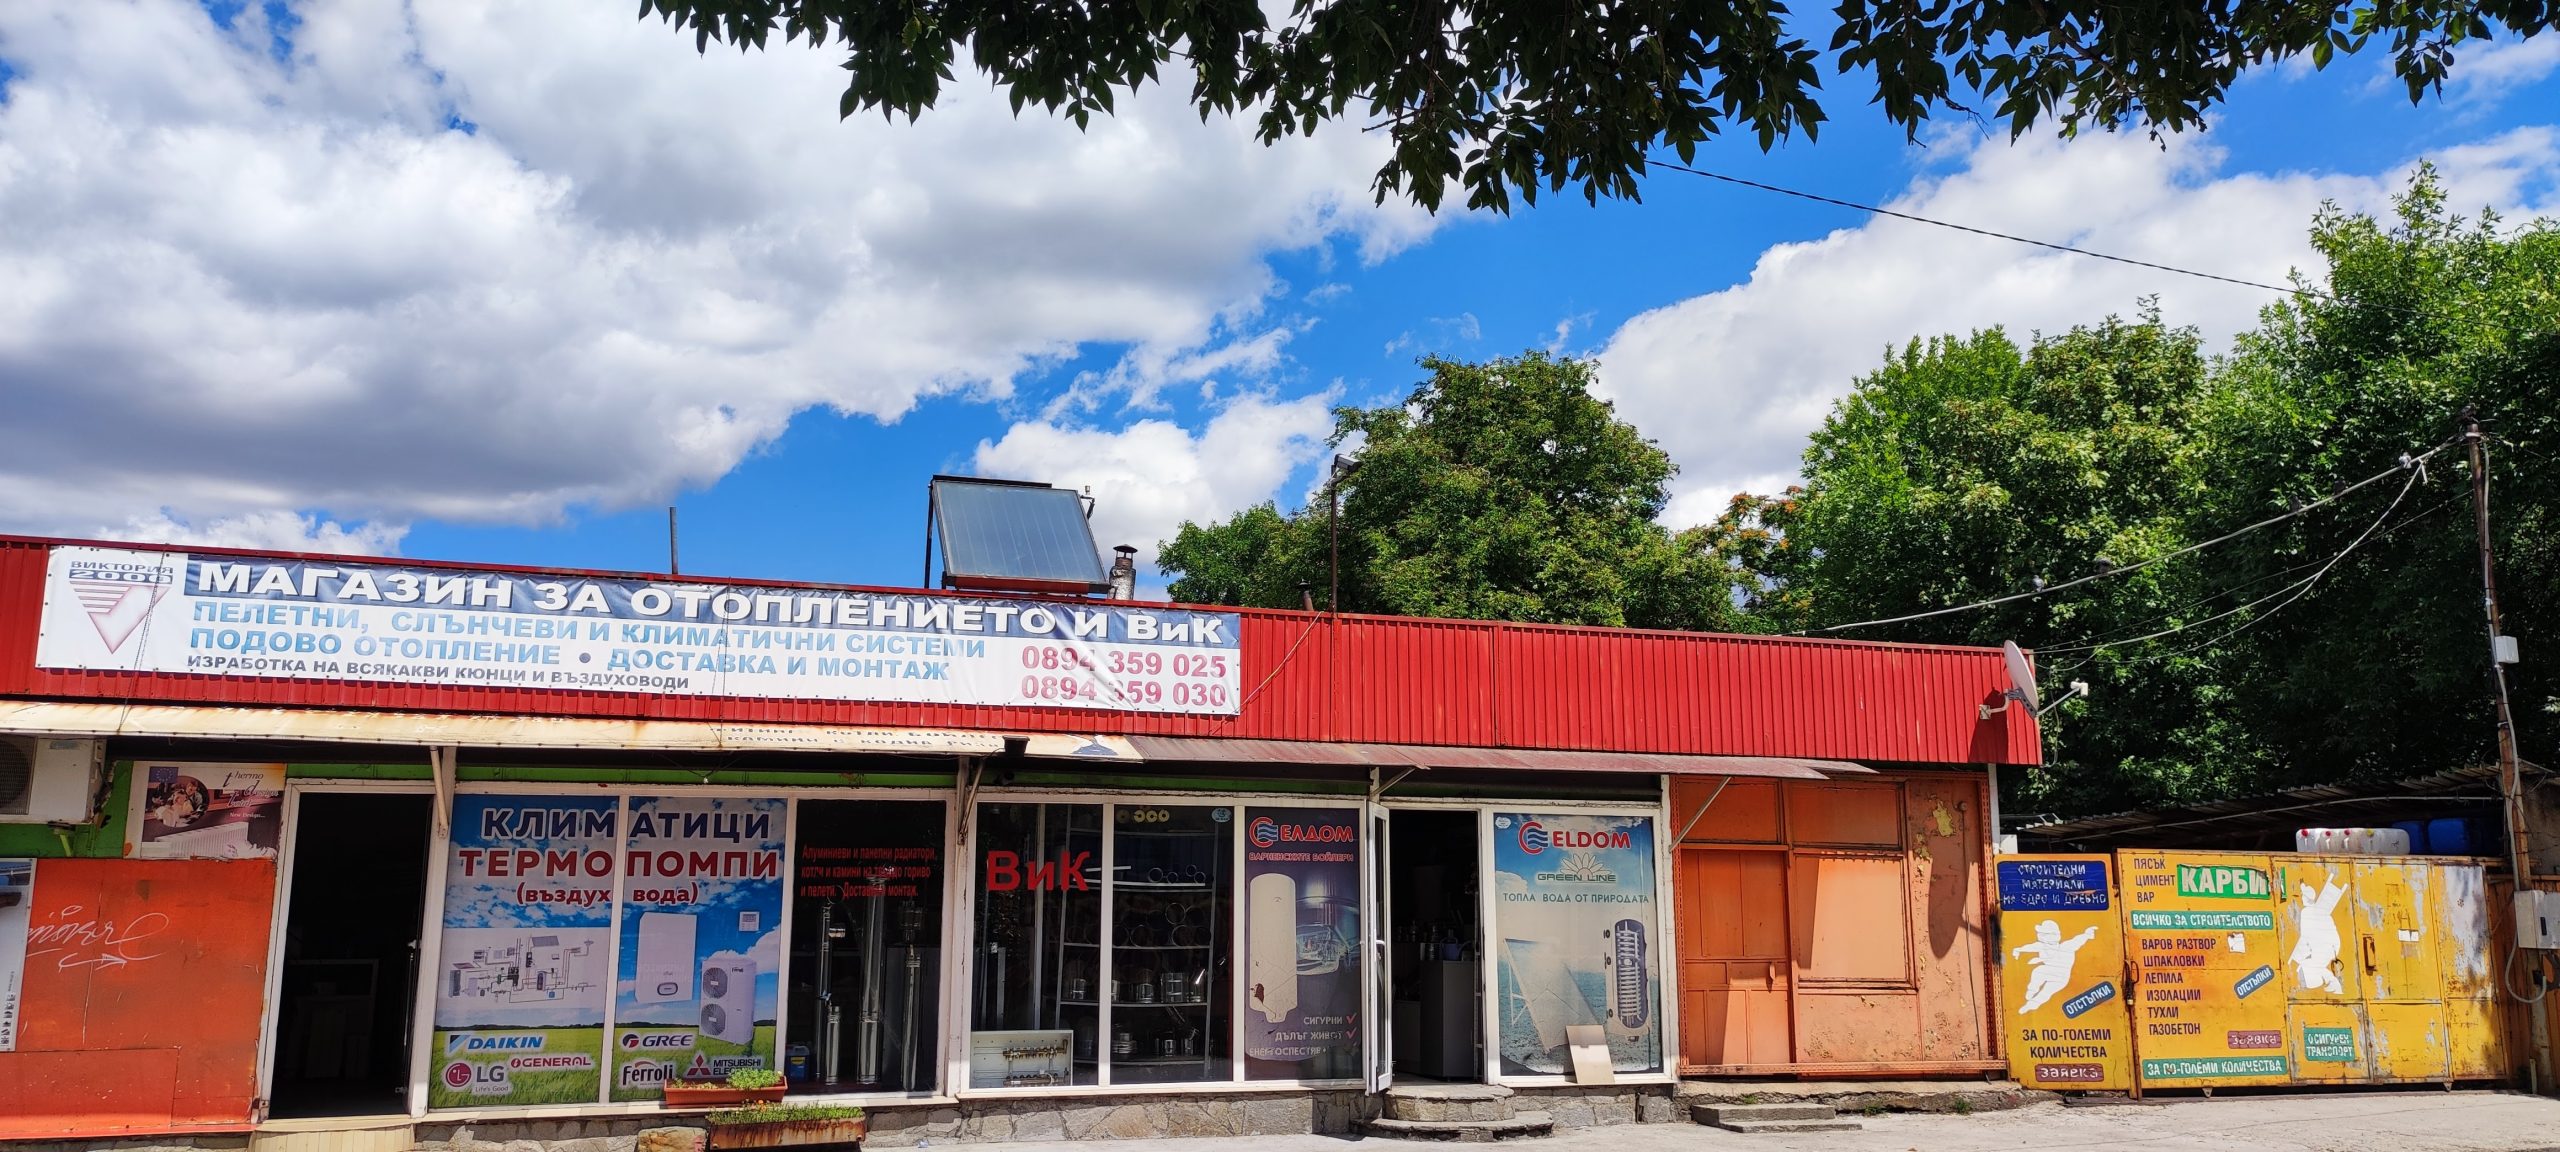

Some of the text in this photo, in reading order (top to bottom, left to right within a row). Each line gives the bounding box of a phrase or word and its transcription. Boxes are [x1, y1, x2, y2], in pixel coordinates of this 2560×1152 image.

[70, 560, 174, 575] ВИКТОРИЯ
[70, 570, 173, 583] 2000
[199, 562, 1223, 644] МАГАЗИН ЗА ОТОПЛЕНИЕТО И ВиК
[193, 601, 985, 658] ПЕЛЕТНИ, СЛЪНЧЕВИ И КЛИМАТИЧНИ СИСТЕМИ
[190, 627, 949, 680] ПОДОВО ОТОПЛЕНИЕ ДОСТАВКА И МОНТАЖ
[1022, 645, 1227, 678] 0894 359 025
[188, 655, 689, 689] ИЗРАБОТКА НА ВСЯКАКВИ КЮНЦИ И ВЪЗДУХОВОДИ
[1021, 675, 1227, 707] 0894 359 030
[1552, 830, 1631, 849] ELDOM
[987, 850, 1091, 891] ВиК
[2134, 857, 2166, 870] ПЯСЪК
[1537, 873, 1616, 882] GREEN LINE
[2135, 874, 2175, 887] ЦИМЕНТ
[2181, 867, 2268, 895] КАРБИ
[517, 882, 699, 907] (въздух вода)
[1503, 893, 1649, 904] ТОПЛА ВОДА ОТ ПРИРОДАТА
[2137, 891, 2155, 903] ВАР
[2133, 913, 2271, 927] ВСИЧКО ЗА СТРОИТЕЛСТВОТО
[2142, 938, 2217, 950] ВАРОВ РАЗТВОР
[2143, 955, 2205, 967] ШПАКЛОВКИ
[2145, 972, 2183, 984] ЛЕПИЛА
[2236, 966, 2273, 996] ОТСТЪПКИ
[2065, 984, 2112, 1015] ОТСТЪПКИ
[2146, 989, 2201, 1003] ИЗОЛАЦИИ
[2147, 1006, 2179, 1019] ТУХЛИ
[1303, 1016, 1343, 1025] СИГУРНИ
[2022, 1028, 2111, 1041] ЗА ПО-ГОЛЕМИ
[2149, 1023, 2201, 1035] ГАЗОБЕТОН
[468, 1036, 544, 1050] DAIKIN
[642, 1034, 693, 1047] GREE
[1275, 1031, 1308, 1042] ДЪЛЪГ
[2030, 1046, 2108, 1058] КОЛИЧЕСТВА
[522, 1056, 592, 1068] GENERAL
[713, 1058, 762, 1067] MITSUBISHI
[2147, 1060, 2282, 1076] ЗА ПО-ГОЛЕМИ КОЛИЧЕСТВА
[476, 1065, 505, 1083] LG
[623, 1062, 673, 1085] Ferroli
